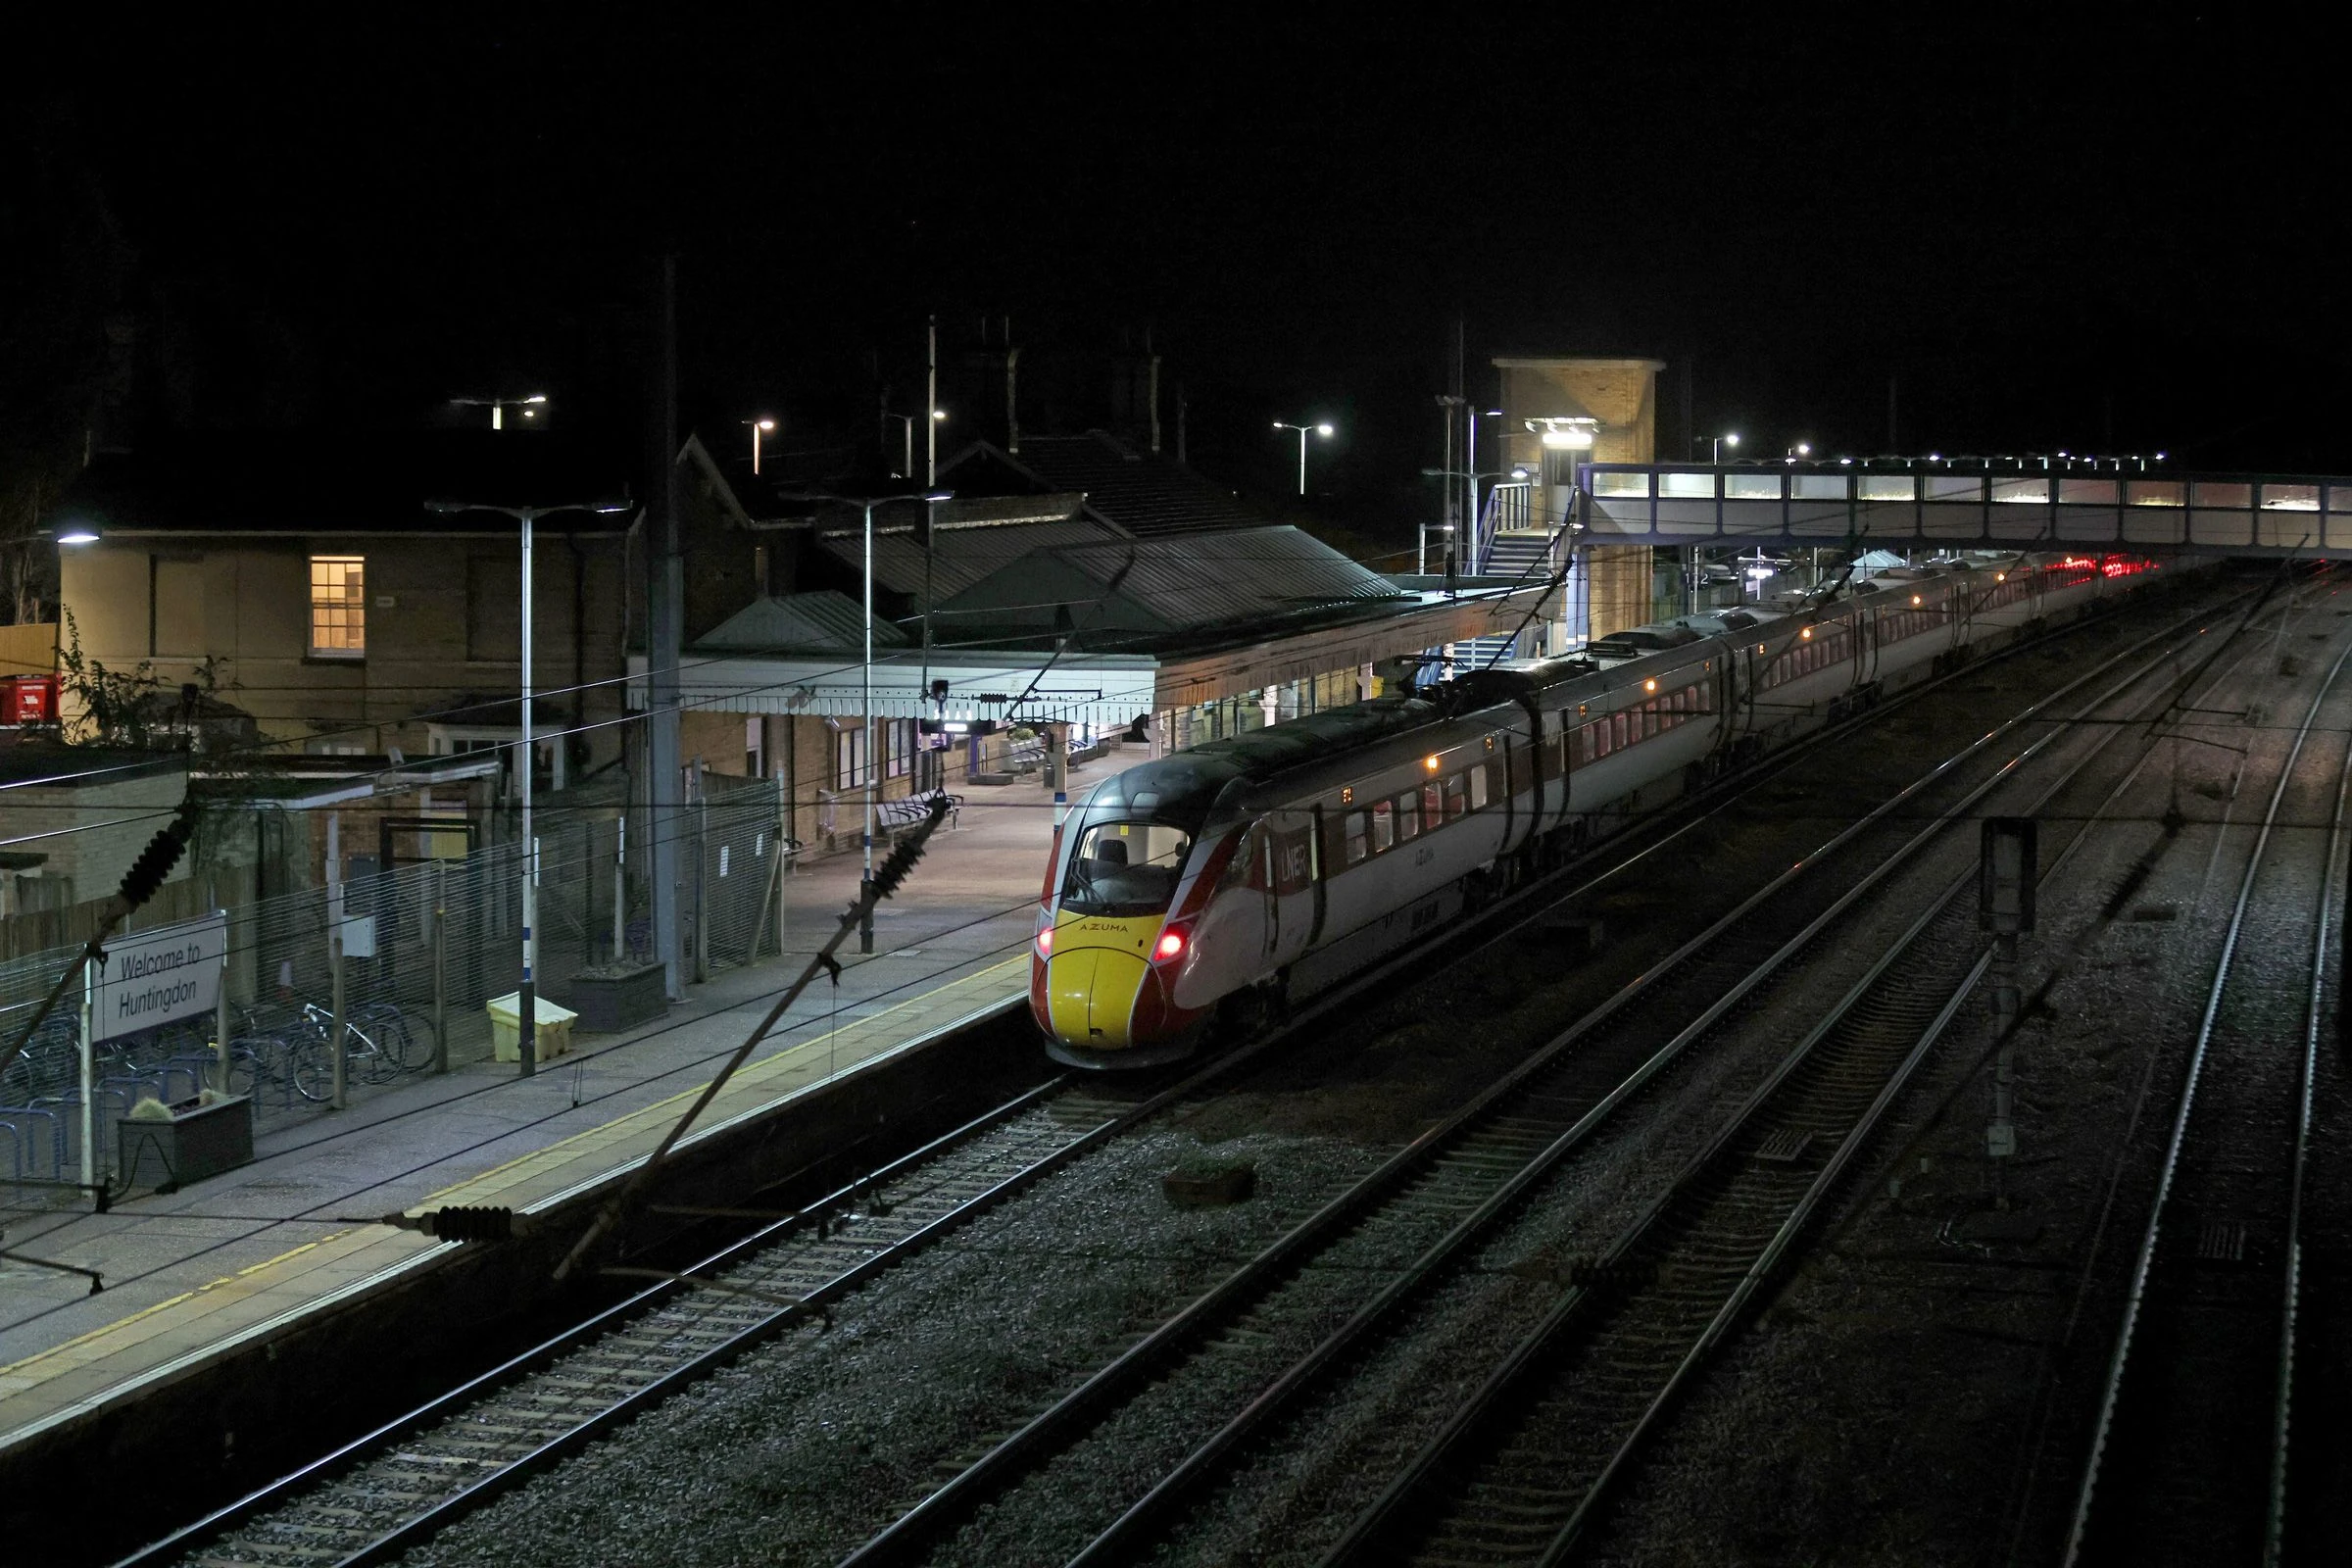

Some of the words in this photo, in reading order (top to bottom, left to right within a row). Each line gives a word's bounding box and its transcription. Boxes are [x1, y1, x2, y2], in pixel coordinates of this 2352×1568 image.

[1700, 572, 1709, 585] 2
[1079, 923, 1129, 933] AZUMA
[121, 949, 184, 979] Welcome
[187, 942, 201, 963] to
[119, 977, 197, 1019] Huntingdon
